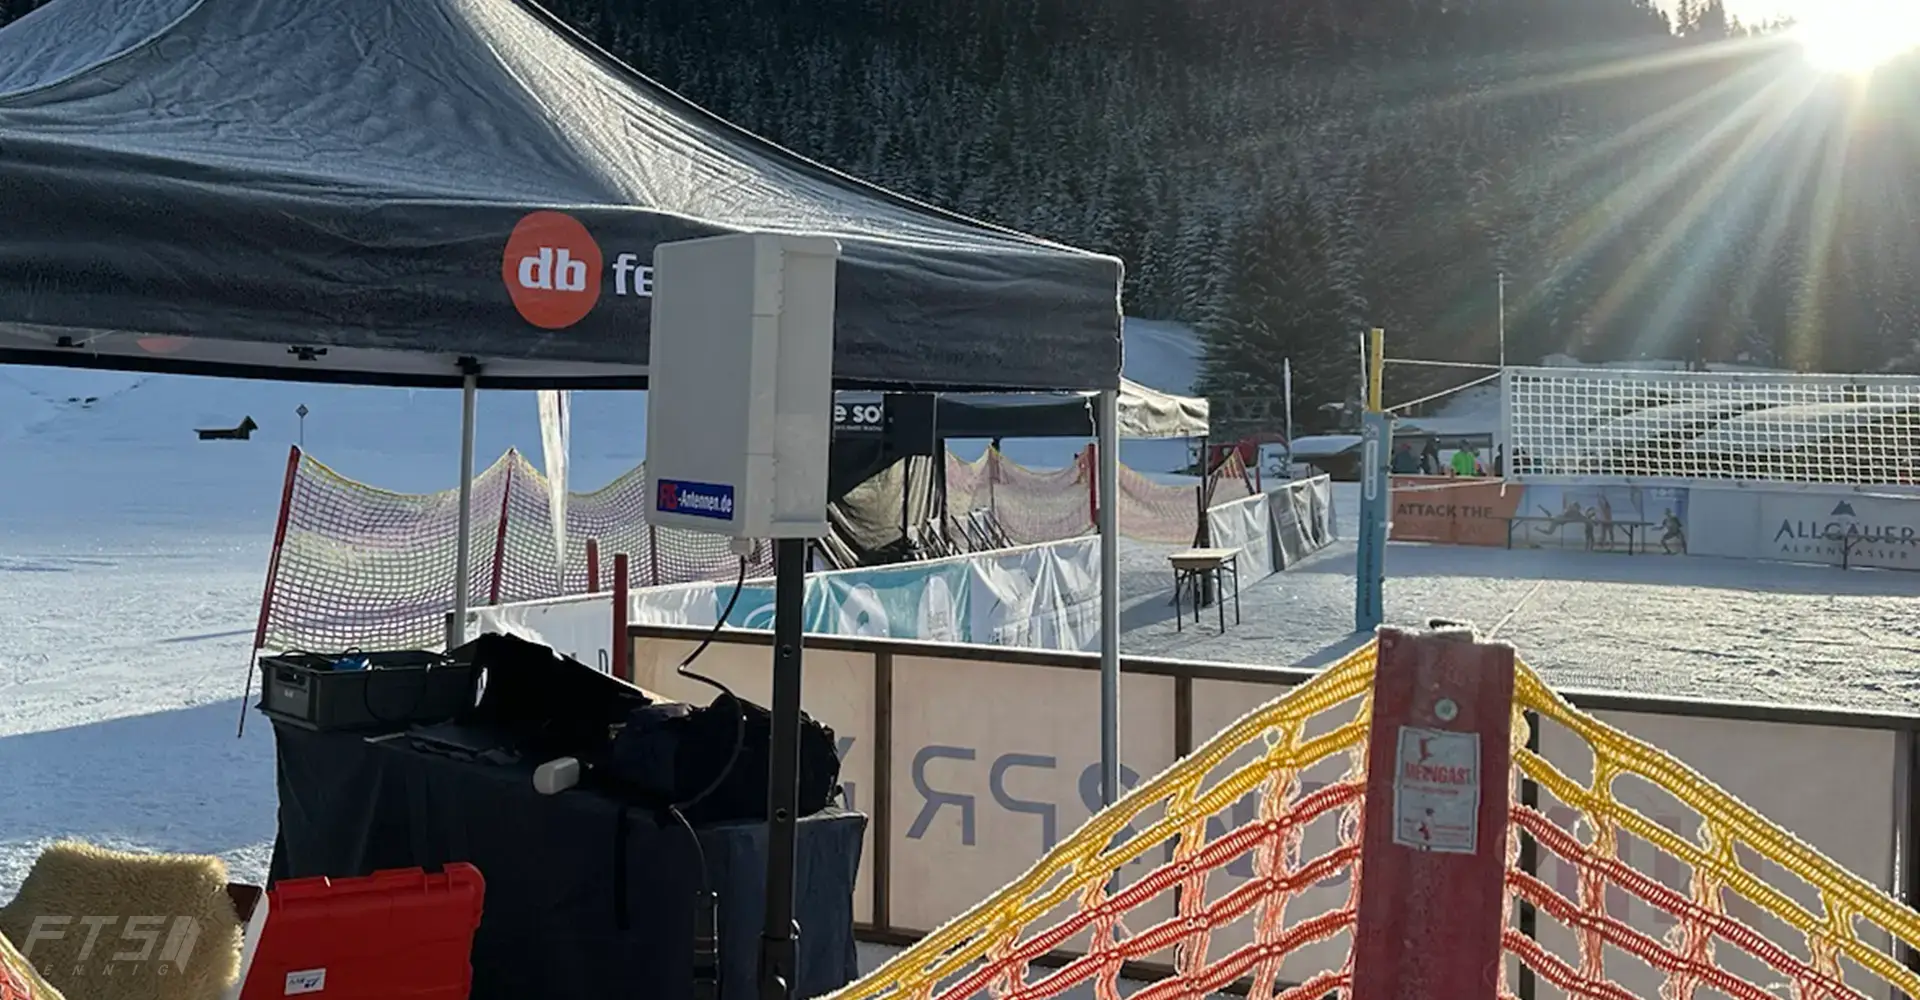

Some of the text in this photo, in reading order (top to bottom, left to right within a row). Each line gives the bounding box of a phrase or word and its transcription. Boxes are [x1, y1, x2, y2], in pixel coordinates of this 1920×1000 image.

[517, 247, 653, 297] db fe
[834, 404, 883, 423] e so
[1397, 503, 1493, 518] ATTACK THE
